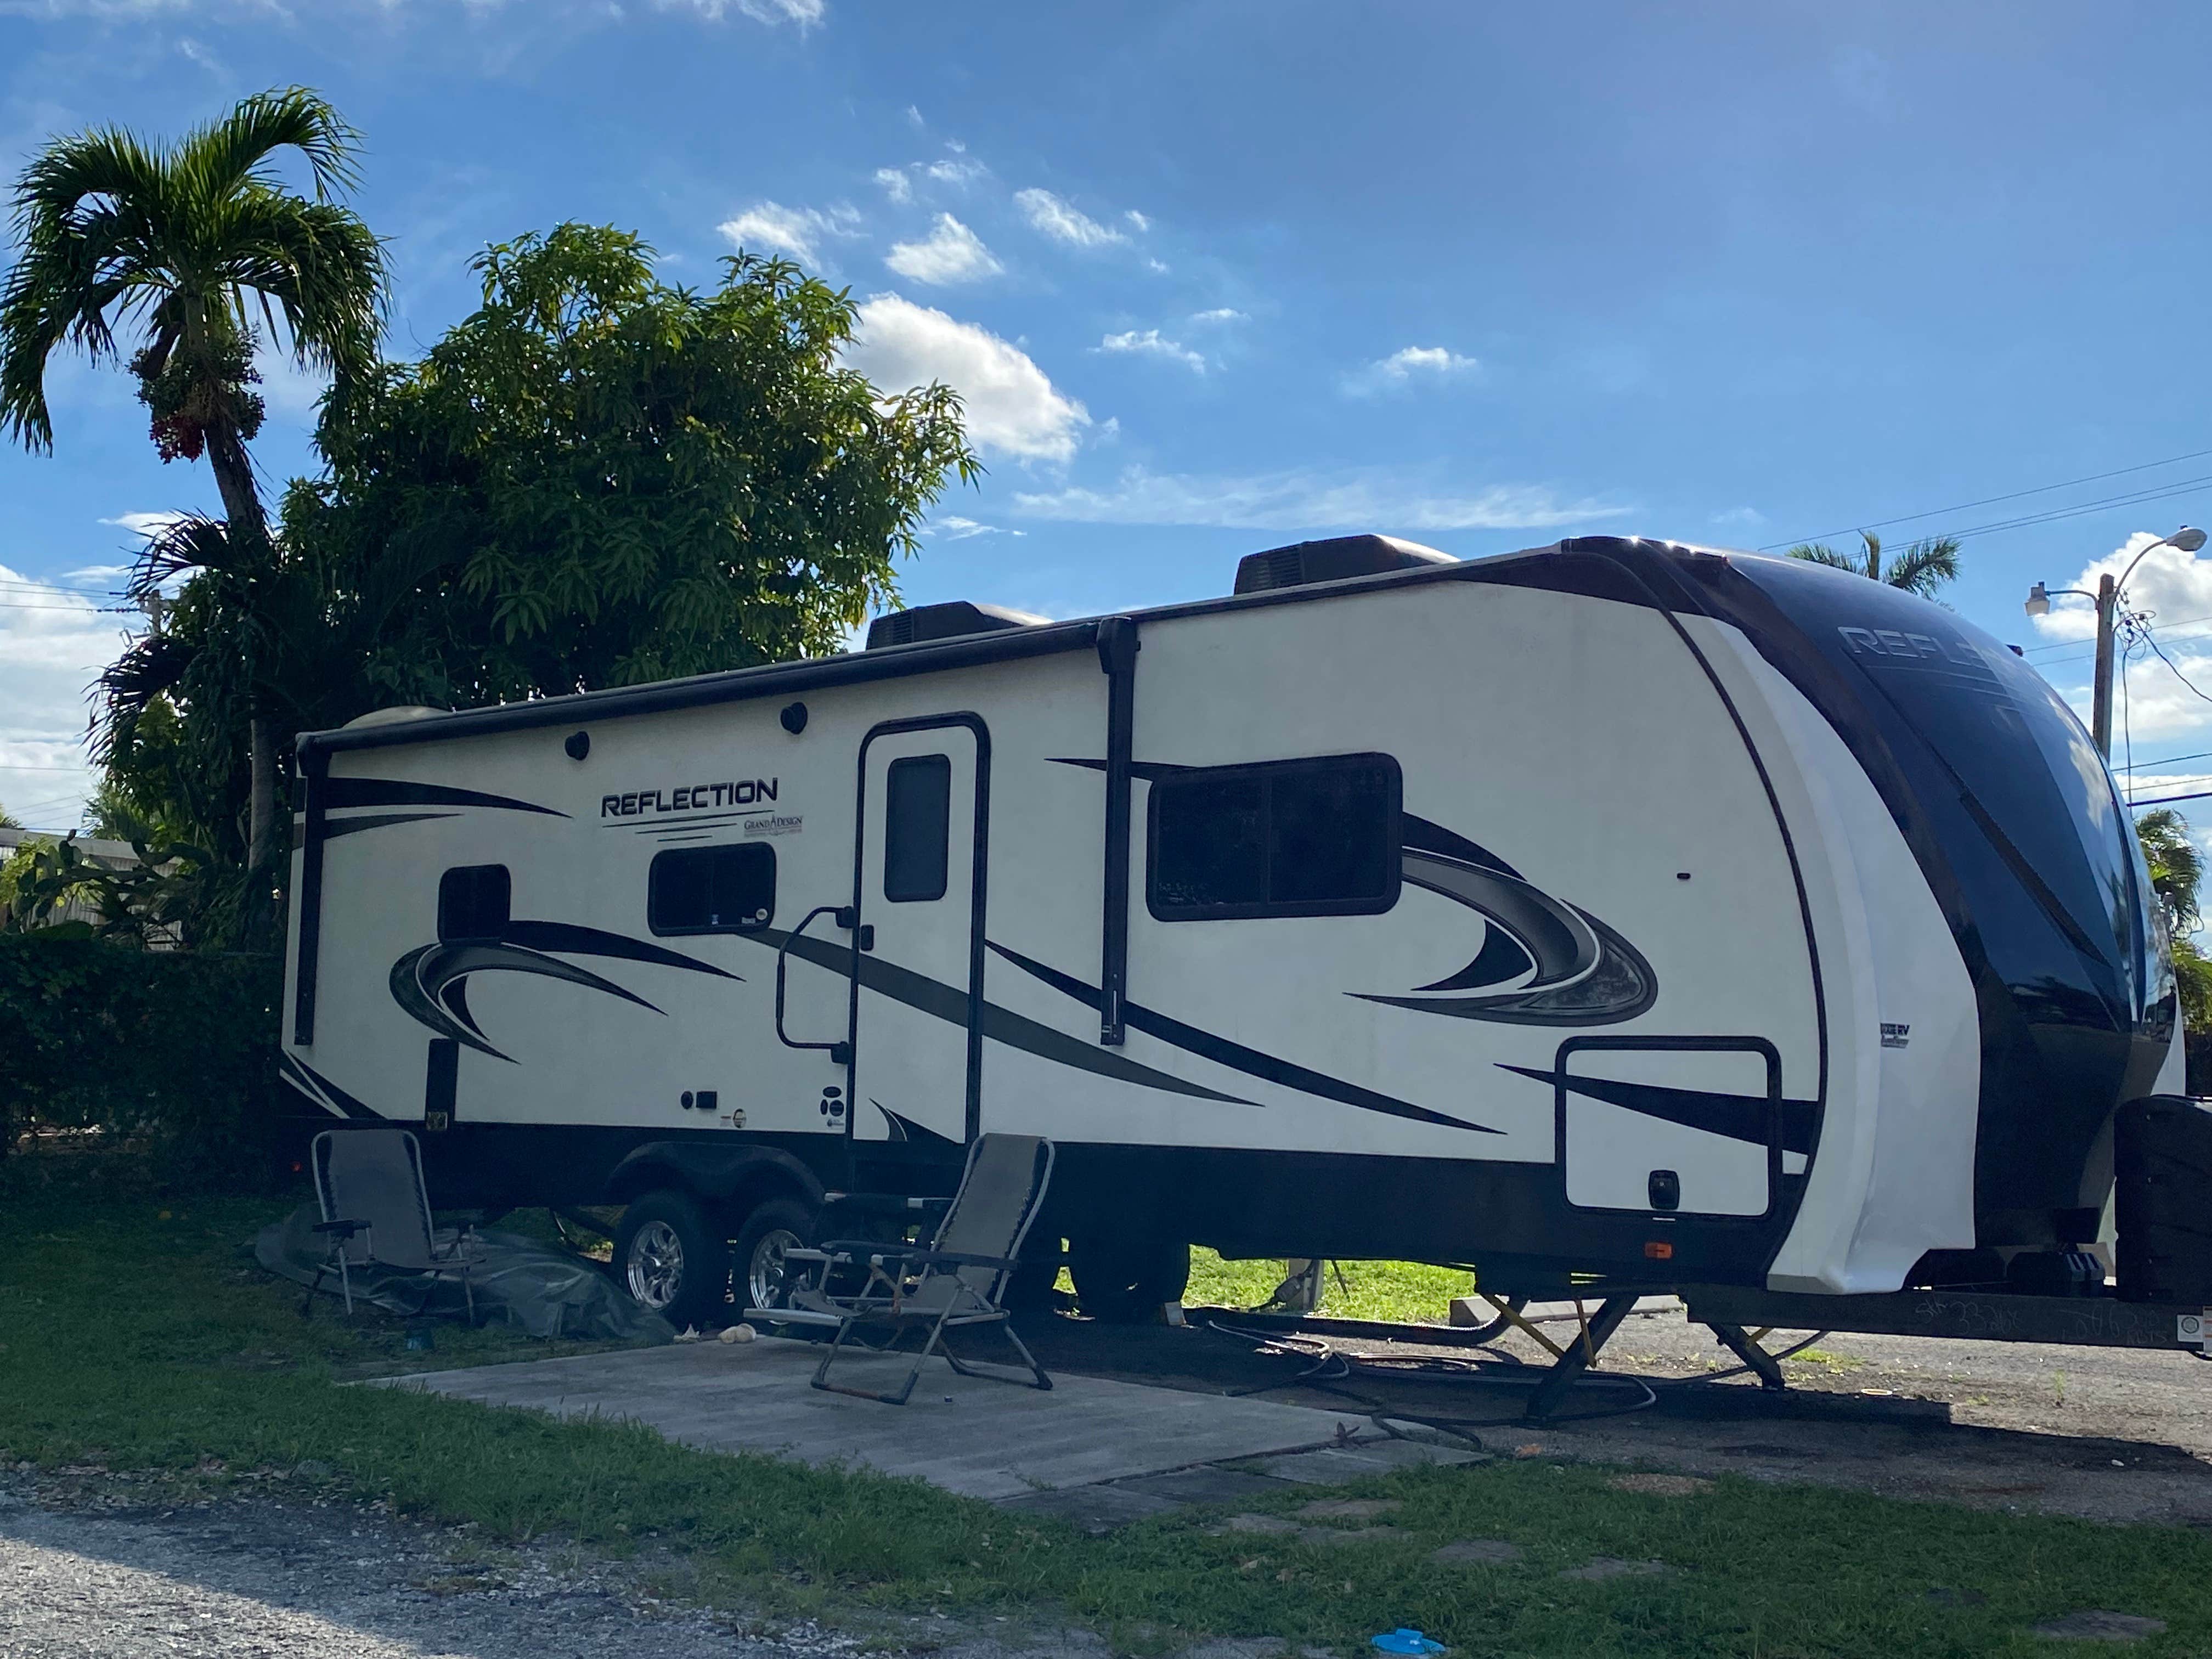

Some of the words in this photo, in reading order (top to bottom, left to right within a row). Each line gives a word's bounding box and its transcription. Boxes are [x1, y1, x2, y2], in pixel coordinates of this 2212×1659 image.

[1838, 627, 1996, 671] REFLE
[601, 777, 778, 817] REFLECTION
[744, 820, 770, 830] GRAND
[777, 815, 803, 827] DESIGN
